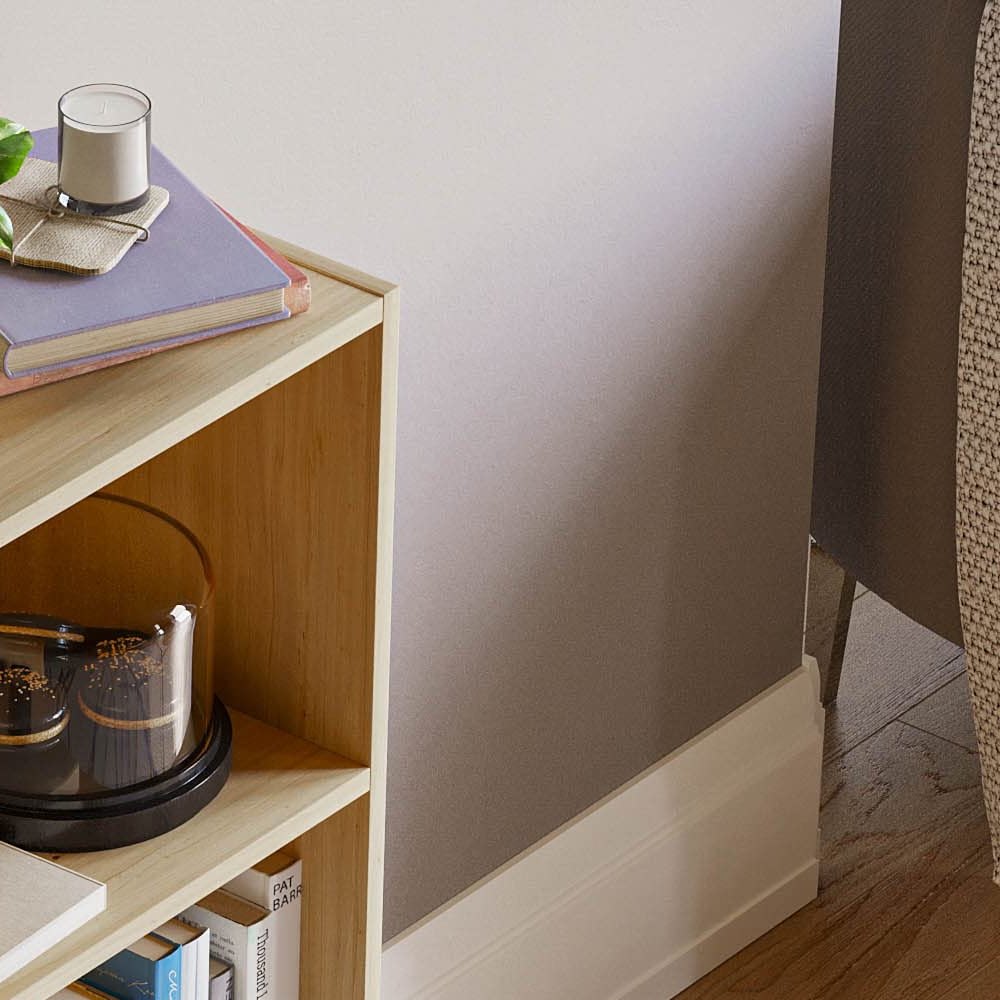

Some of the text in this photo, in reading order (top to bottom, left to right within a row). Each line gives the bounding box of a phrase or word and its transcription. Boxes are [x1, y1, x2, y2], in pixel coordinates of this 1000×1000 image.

[272, 884, 302, 911] BARR
[273, 875, 294, 896] PAT
[257, 929, 269, 993] Thousand
